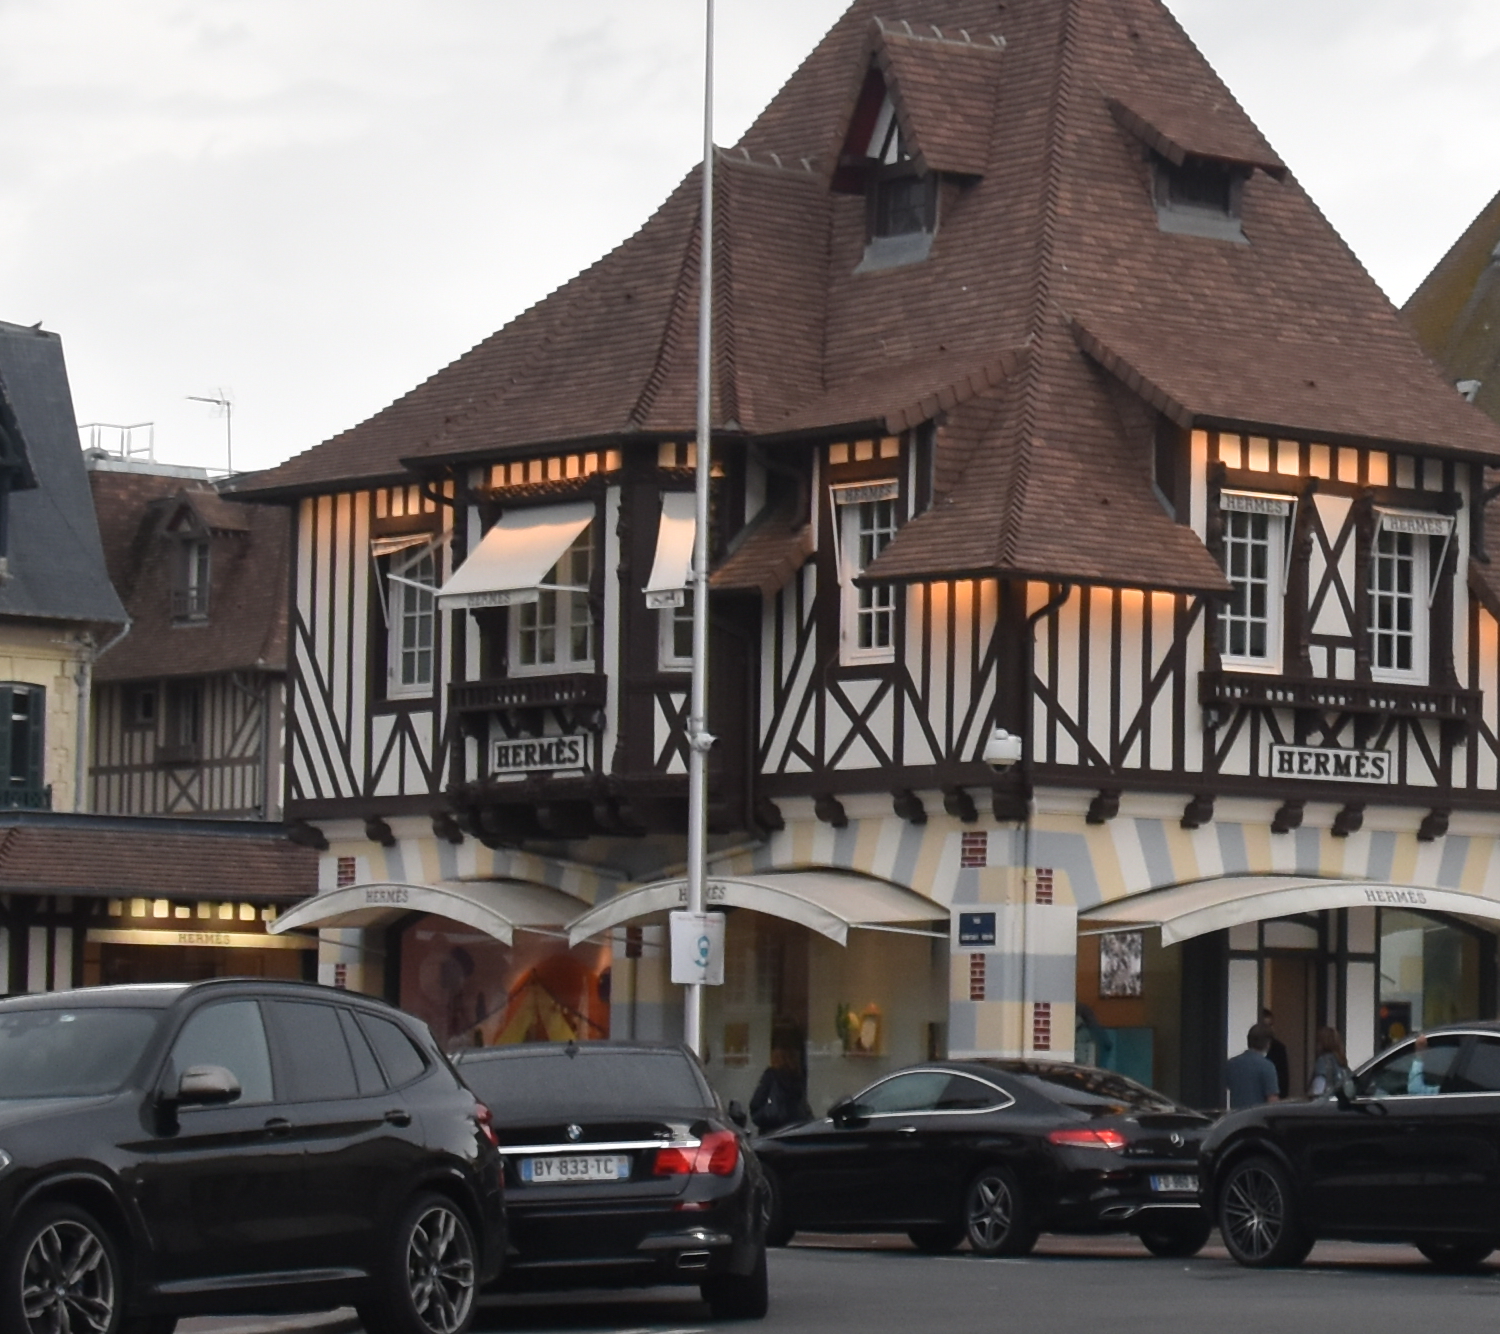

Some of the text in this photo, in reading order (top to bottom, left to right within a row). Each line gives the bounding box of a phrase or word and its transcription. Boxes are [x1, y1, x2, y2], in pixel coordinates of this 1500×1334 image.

[497, 738, 580, 768] HERMÈS
[1277, 751, 1385, 780] HERMÈS
[534, 1159, 613, 1177] BY-833-TC
